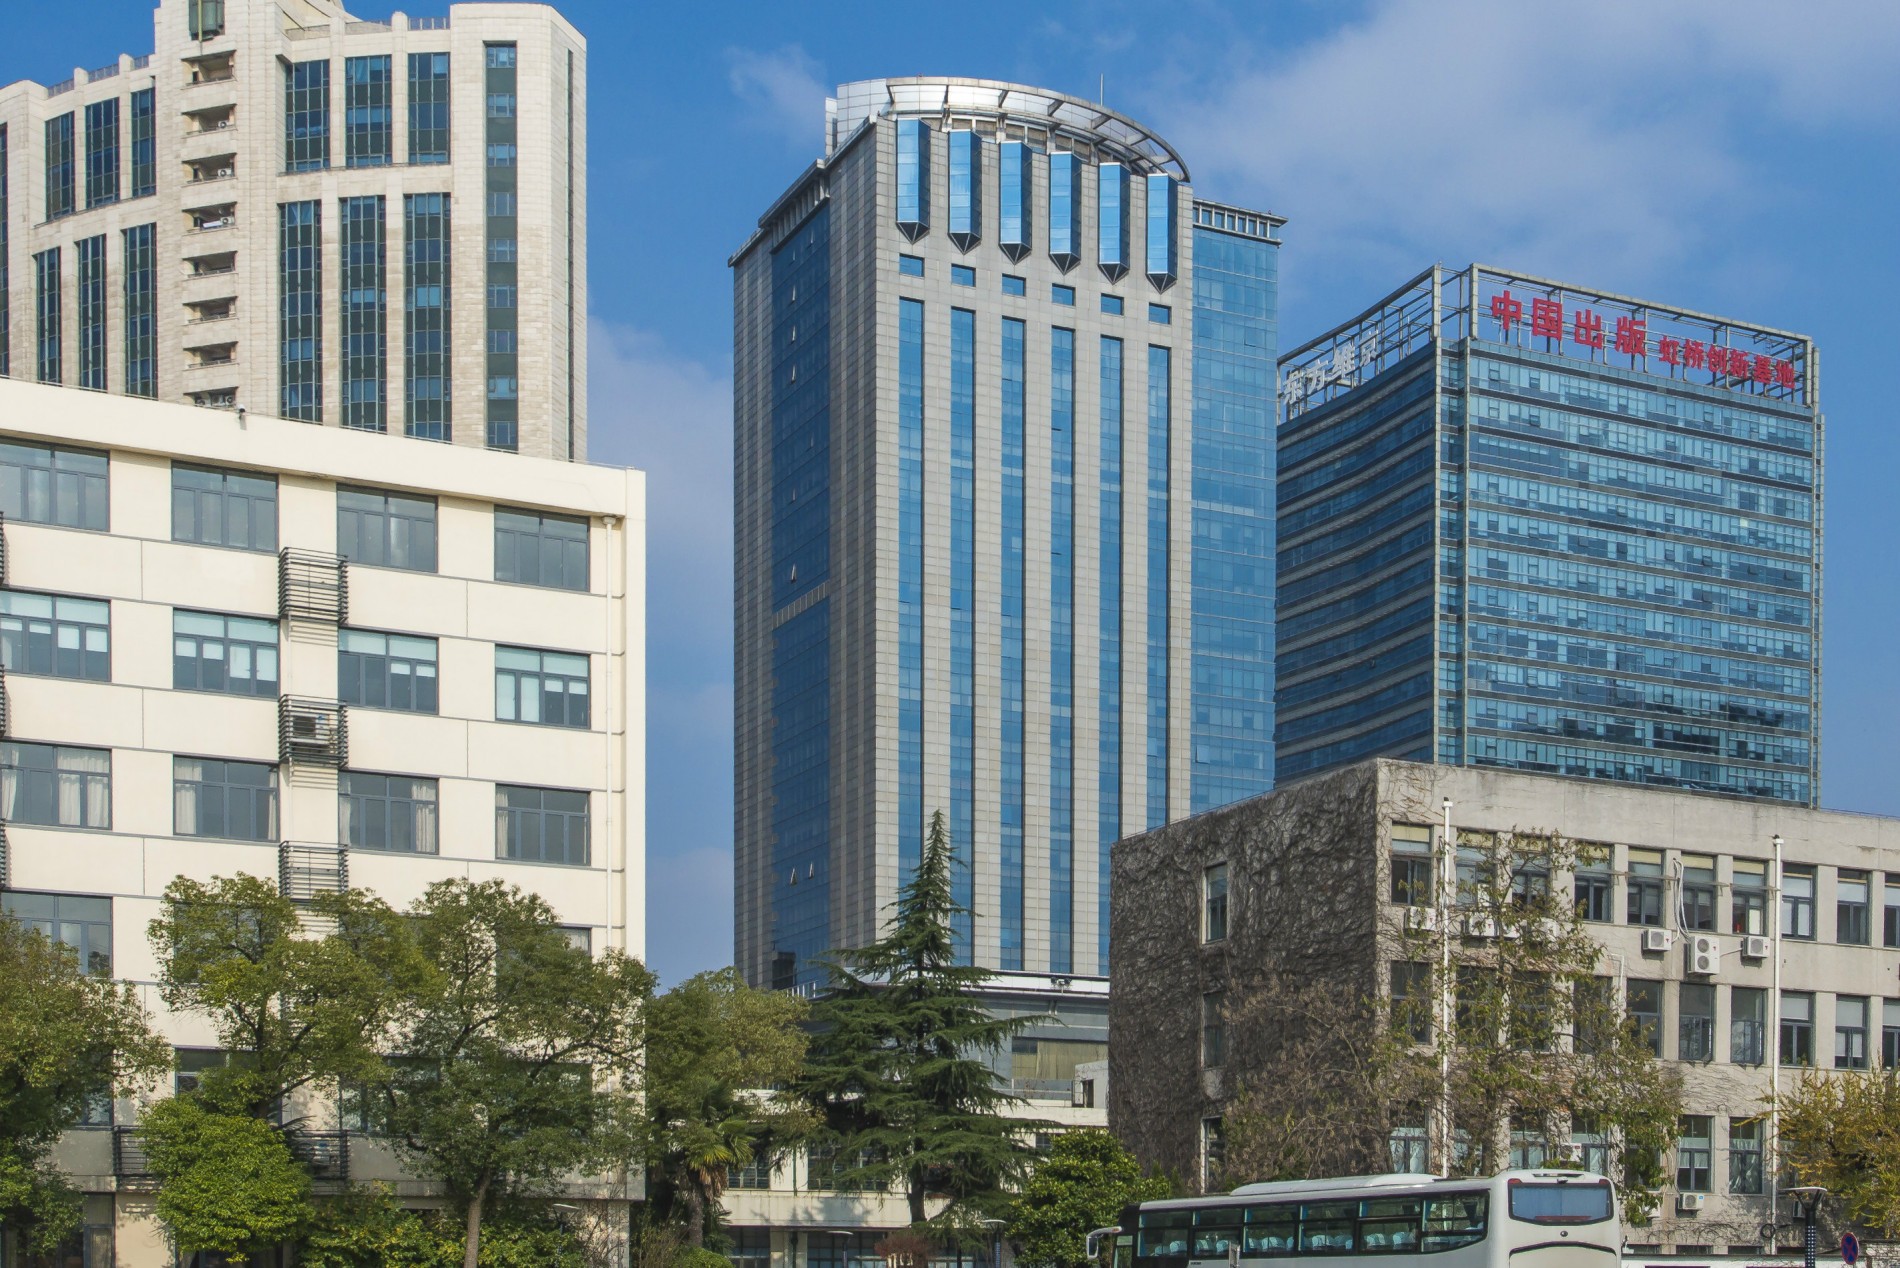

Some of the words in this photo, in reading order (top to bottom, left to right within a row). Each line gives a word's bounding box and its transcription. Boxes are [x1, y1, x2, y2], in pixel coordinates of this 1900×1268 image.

[1491, 290, 1647, 356] 中国出版
[1658, 336, 1795, 388] 虹桥创新基地
